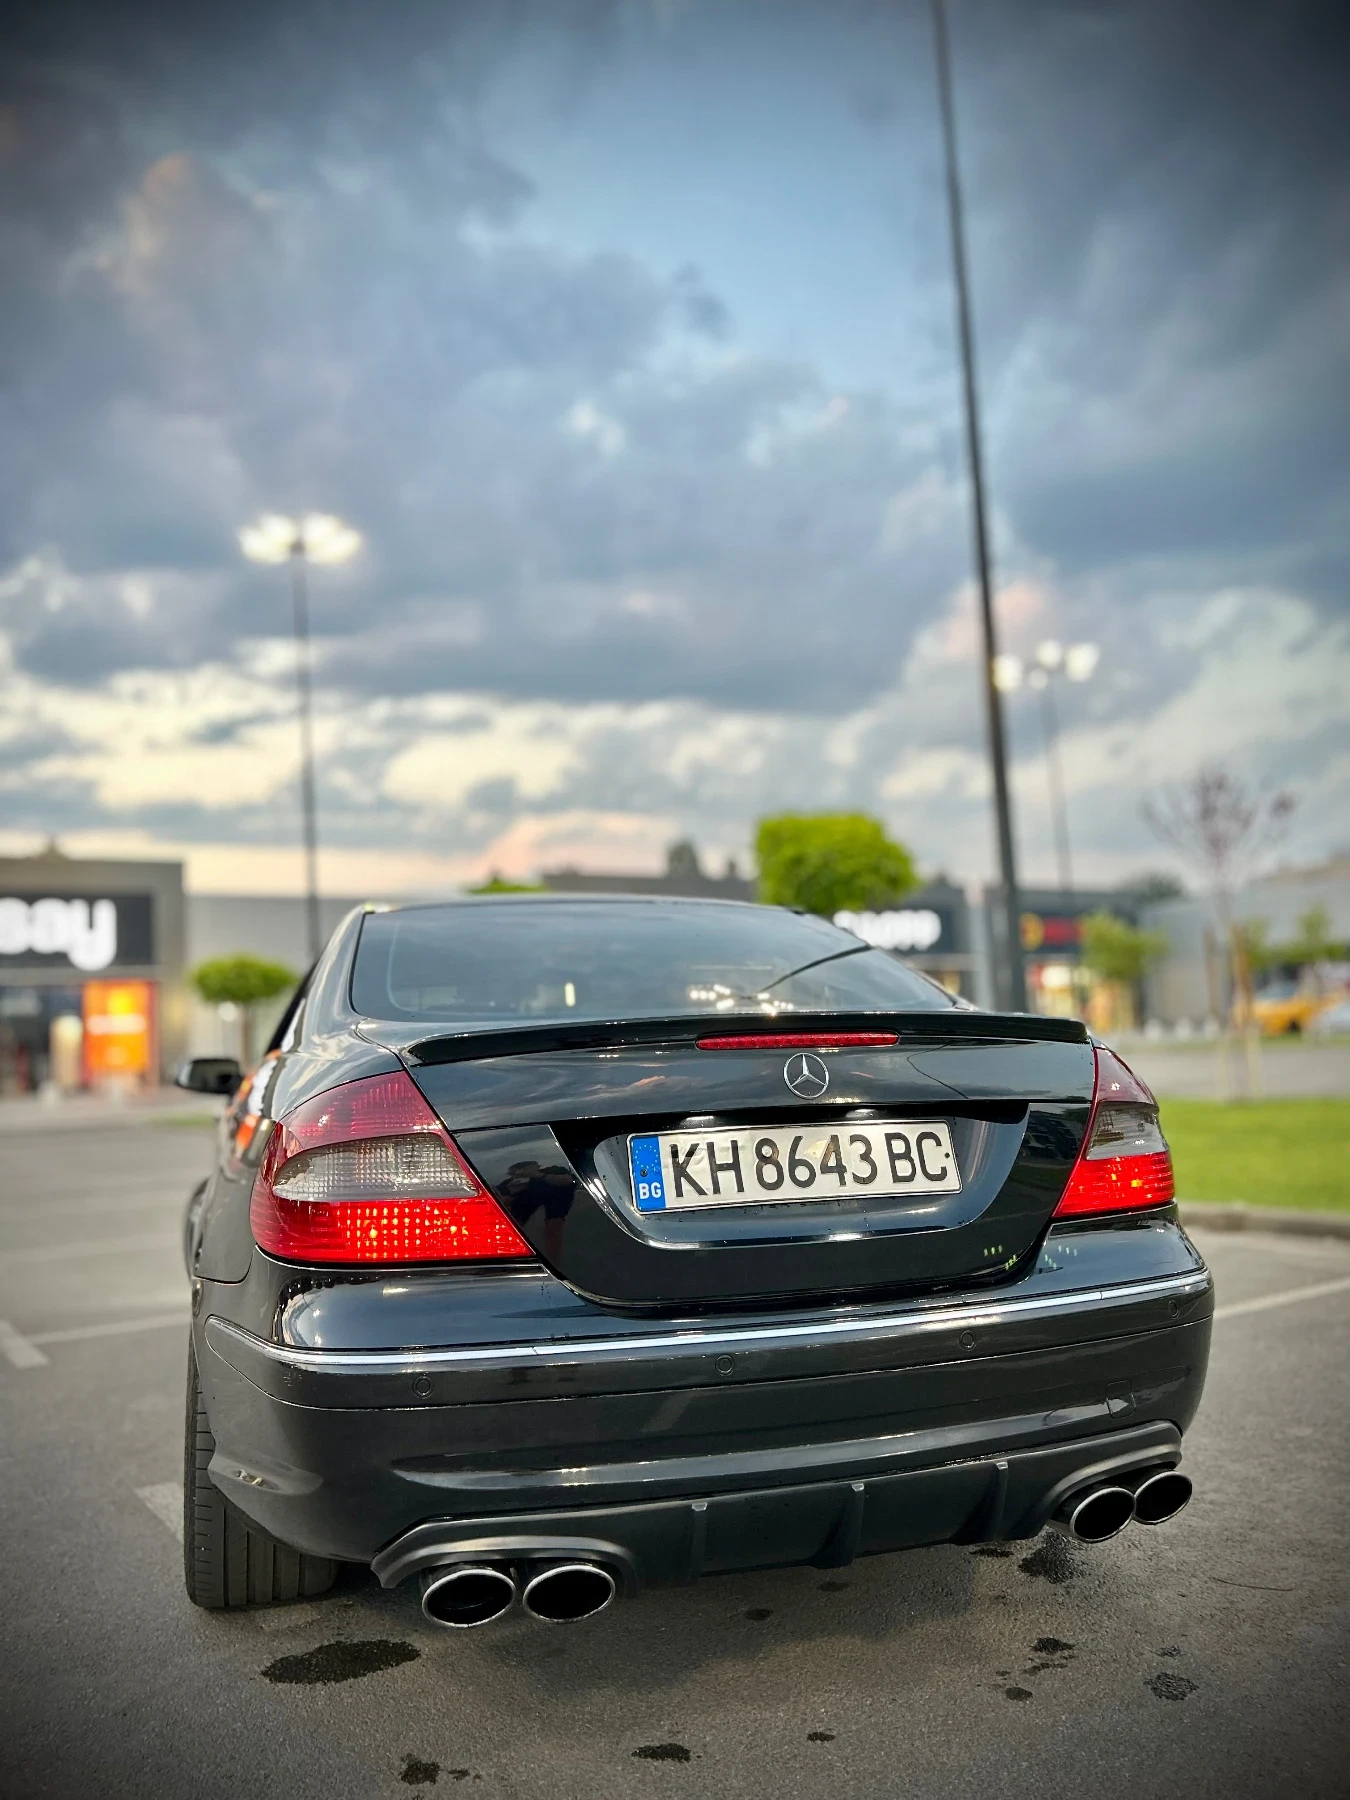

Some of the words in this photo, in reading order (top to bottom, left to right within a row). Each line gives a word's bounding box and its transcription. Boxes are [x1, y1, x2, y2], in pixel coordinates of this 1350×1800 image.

[670, 1140, 744, 1197] KH
[755, 1134, 877, 1190] 8643
[884, 1131, 947, 1184] BC
[639, 1182, 661, 1199] BG
